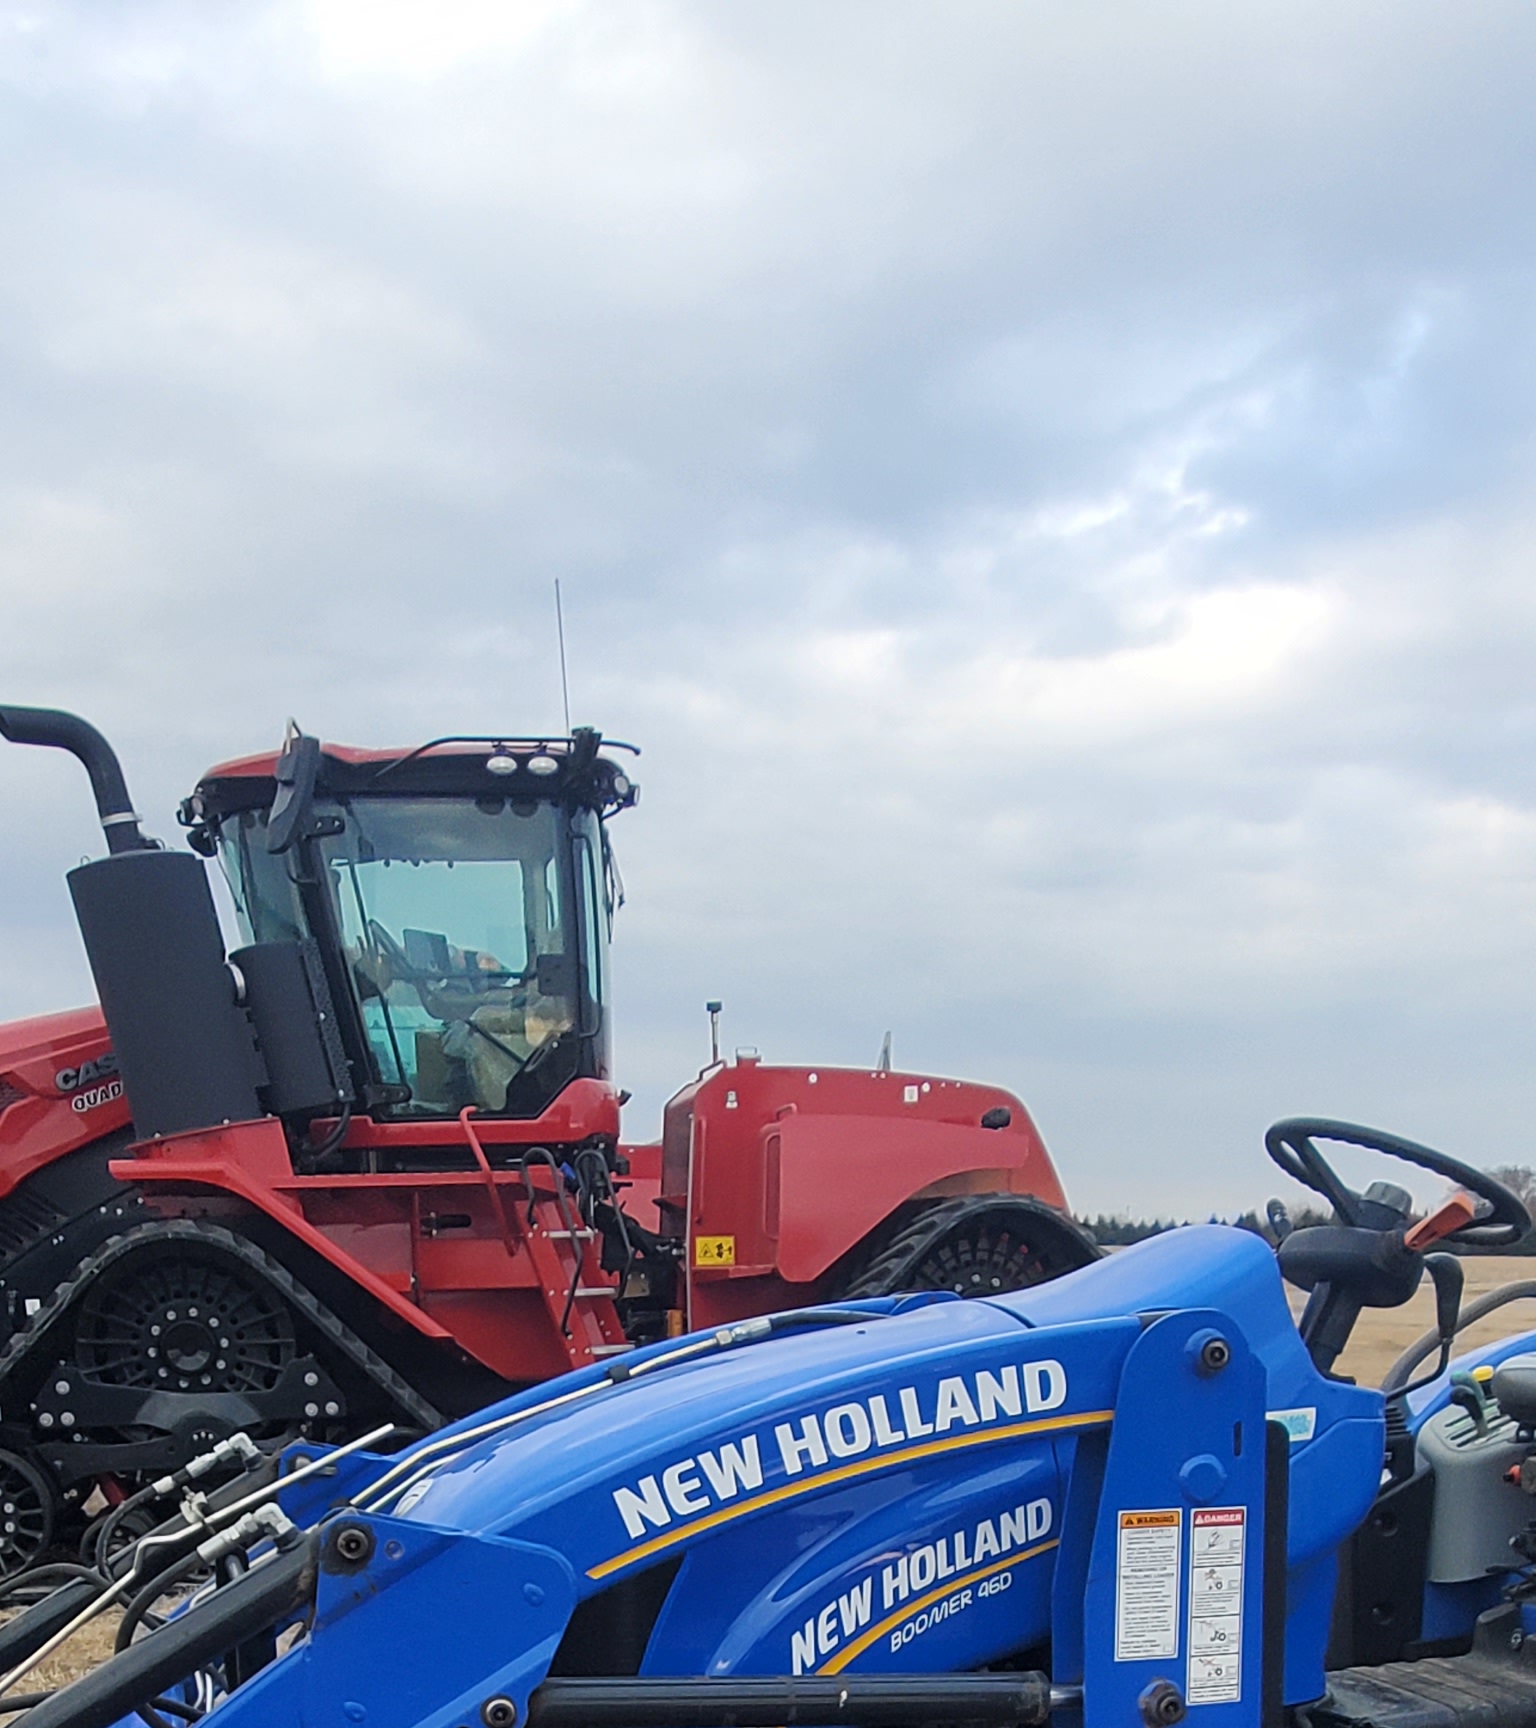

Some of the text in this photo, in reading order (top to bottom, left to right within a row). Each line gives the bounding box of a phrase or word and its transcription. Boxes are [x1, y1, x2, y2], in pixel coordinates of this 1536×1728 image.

[72, 1082, 123, 1113] QUAD
[612, 1359, 1067, 1539] NEW HOLLAND
[1203, 1512, 1242, 1523] DANGER
[791, 1498, 1053, 1676] NEW HOLLAND
[891, 1572, 1012, 1653] BOOMER 46D
